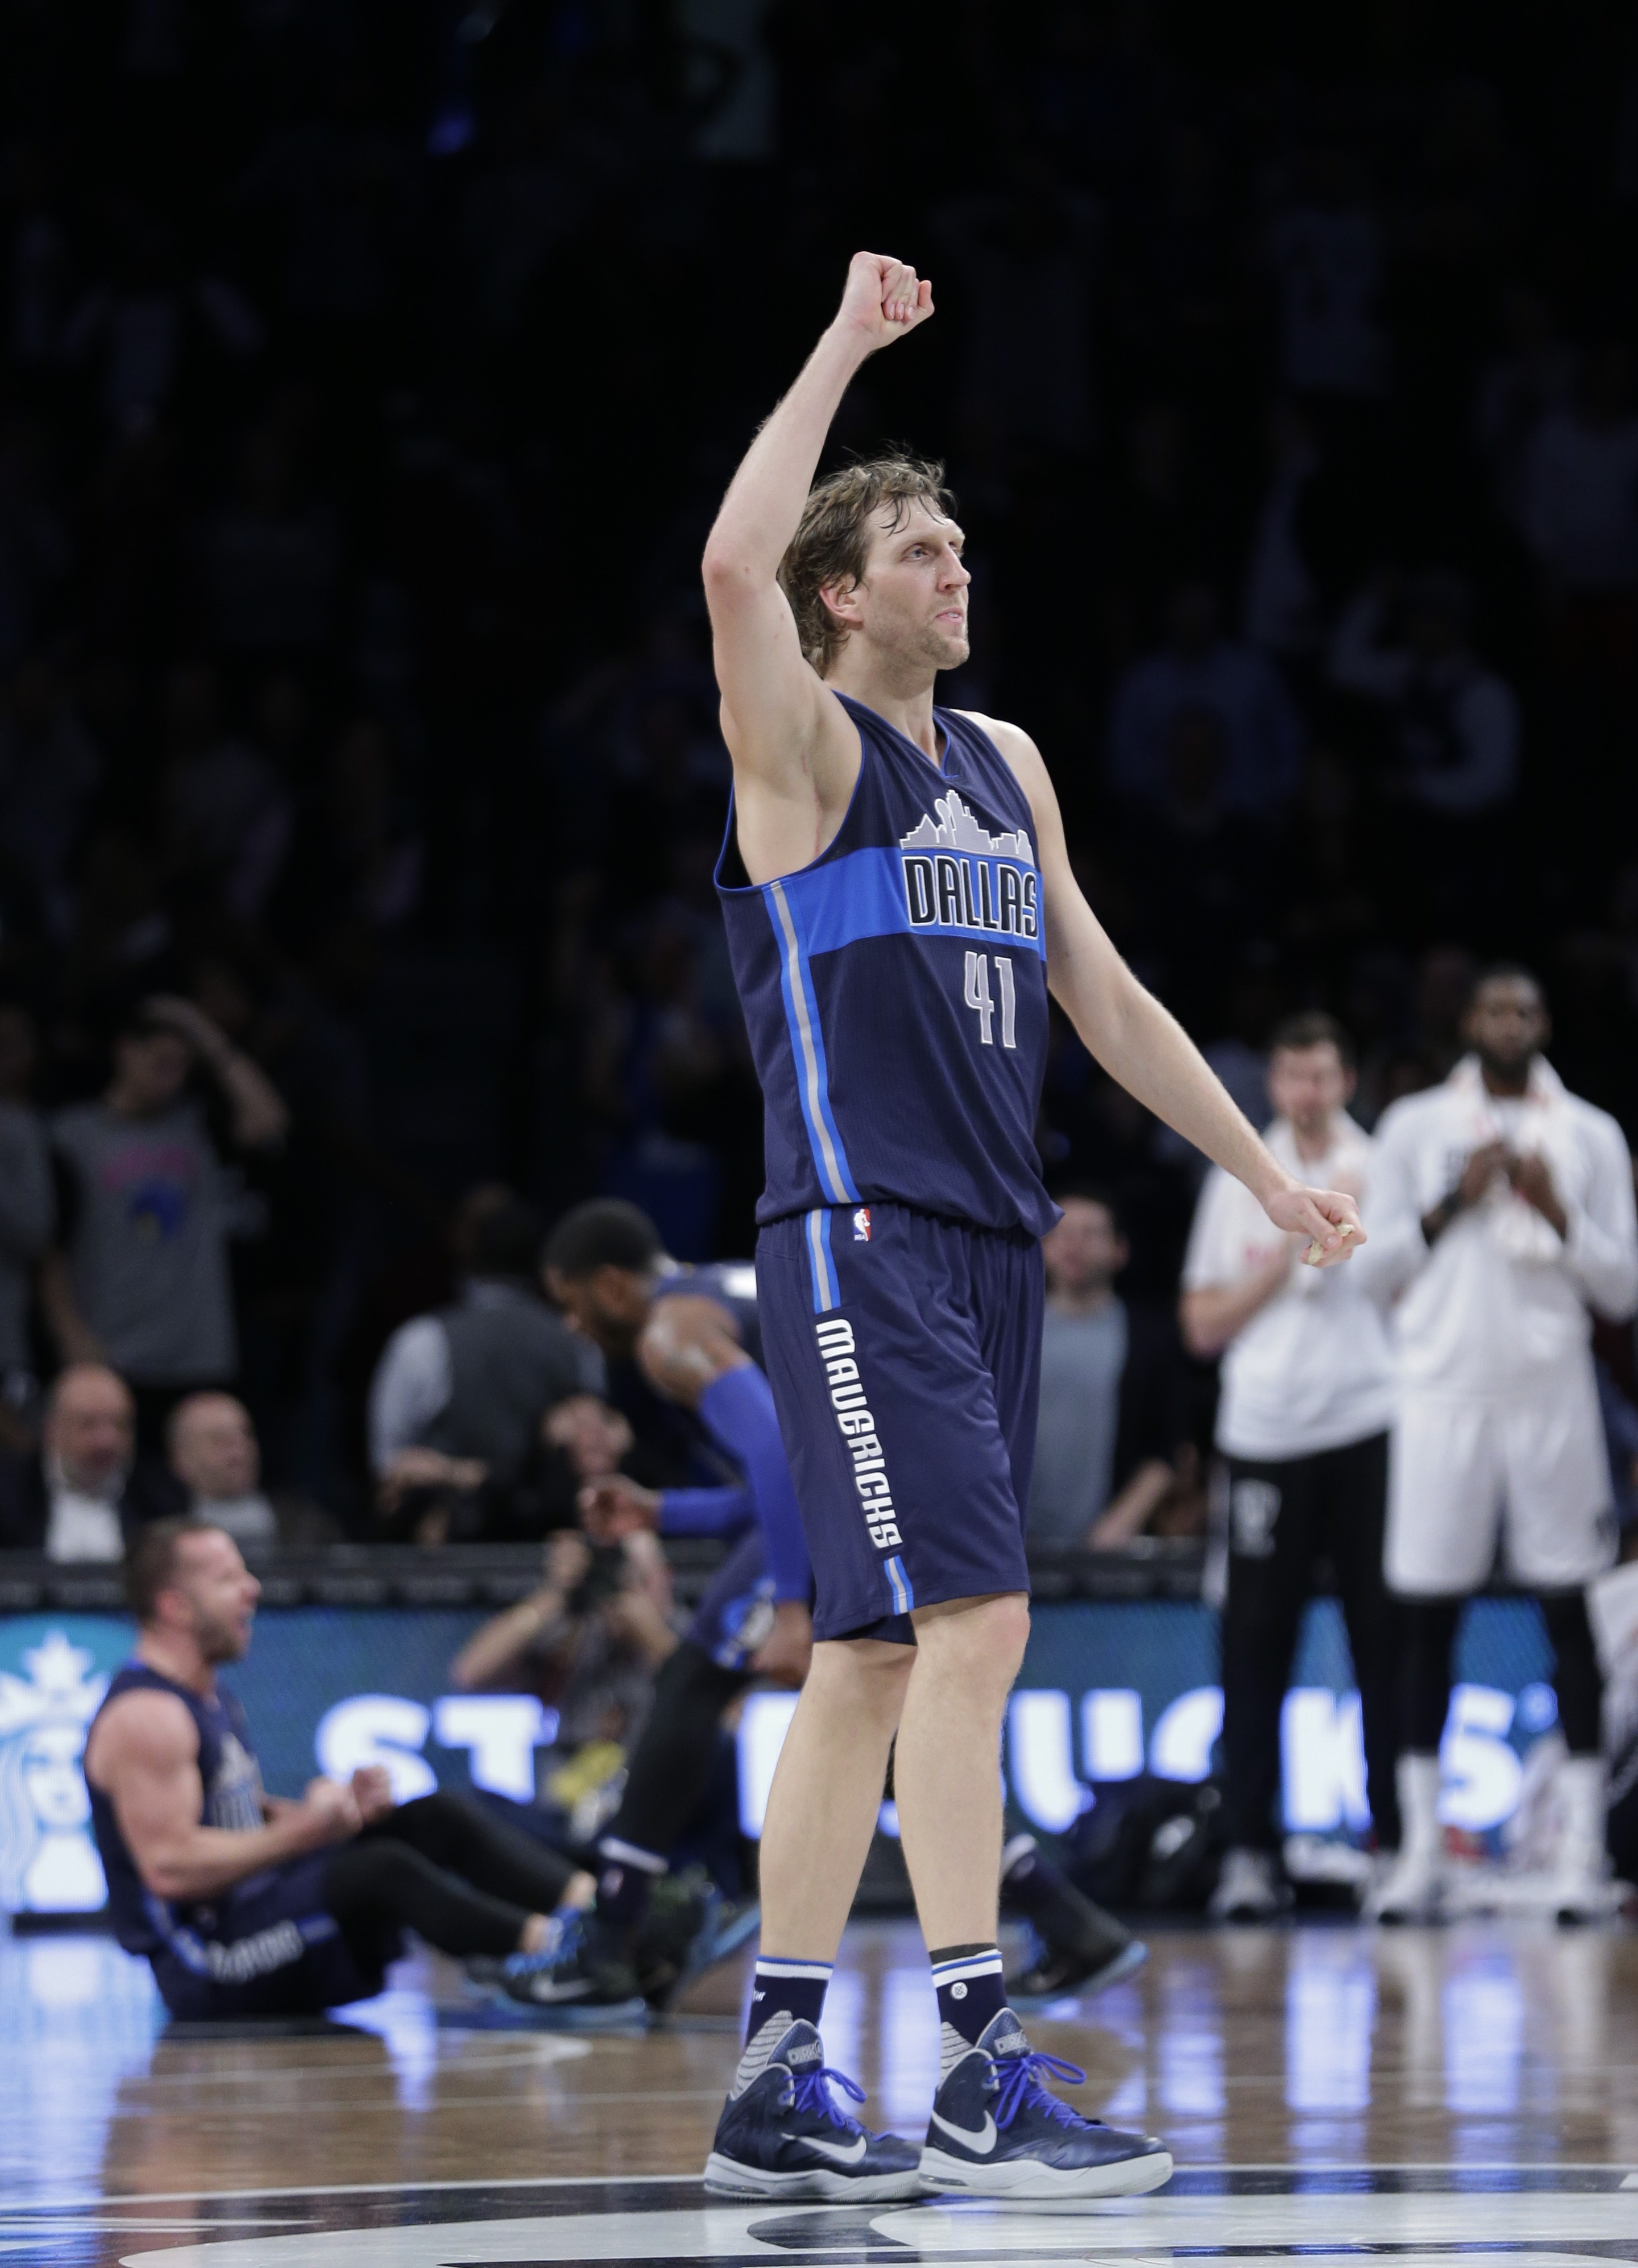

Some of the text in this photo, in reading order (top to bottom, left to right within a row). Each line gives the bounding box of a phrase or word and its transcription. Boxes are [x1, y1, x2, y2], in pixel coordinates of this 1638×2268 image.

[902, 855, 1039, 940] DALLAS
[964, 950, 1017, 1049] 41
[816, 1318, 903, 1549] MAVERICKS
